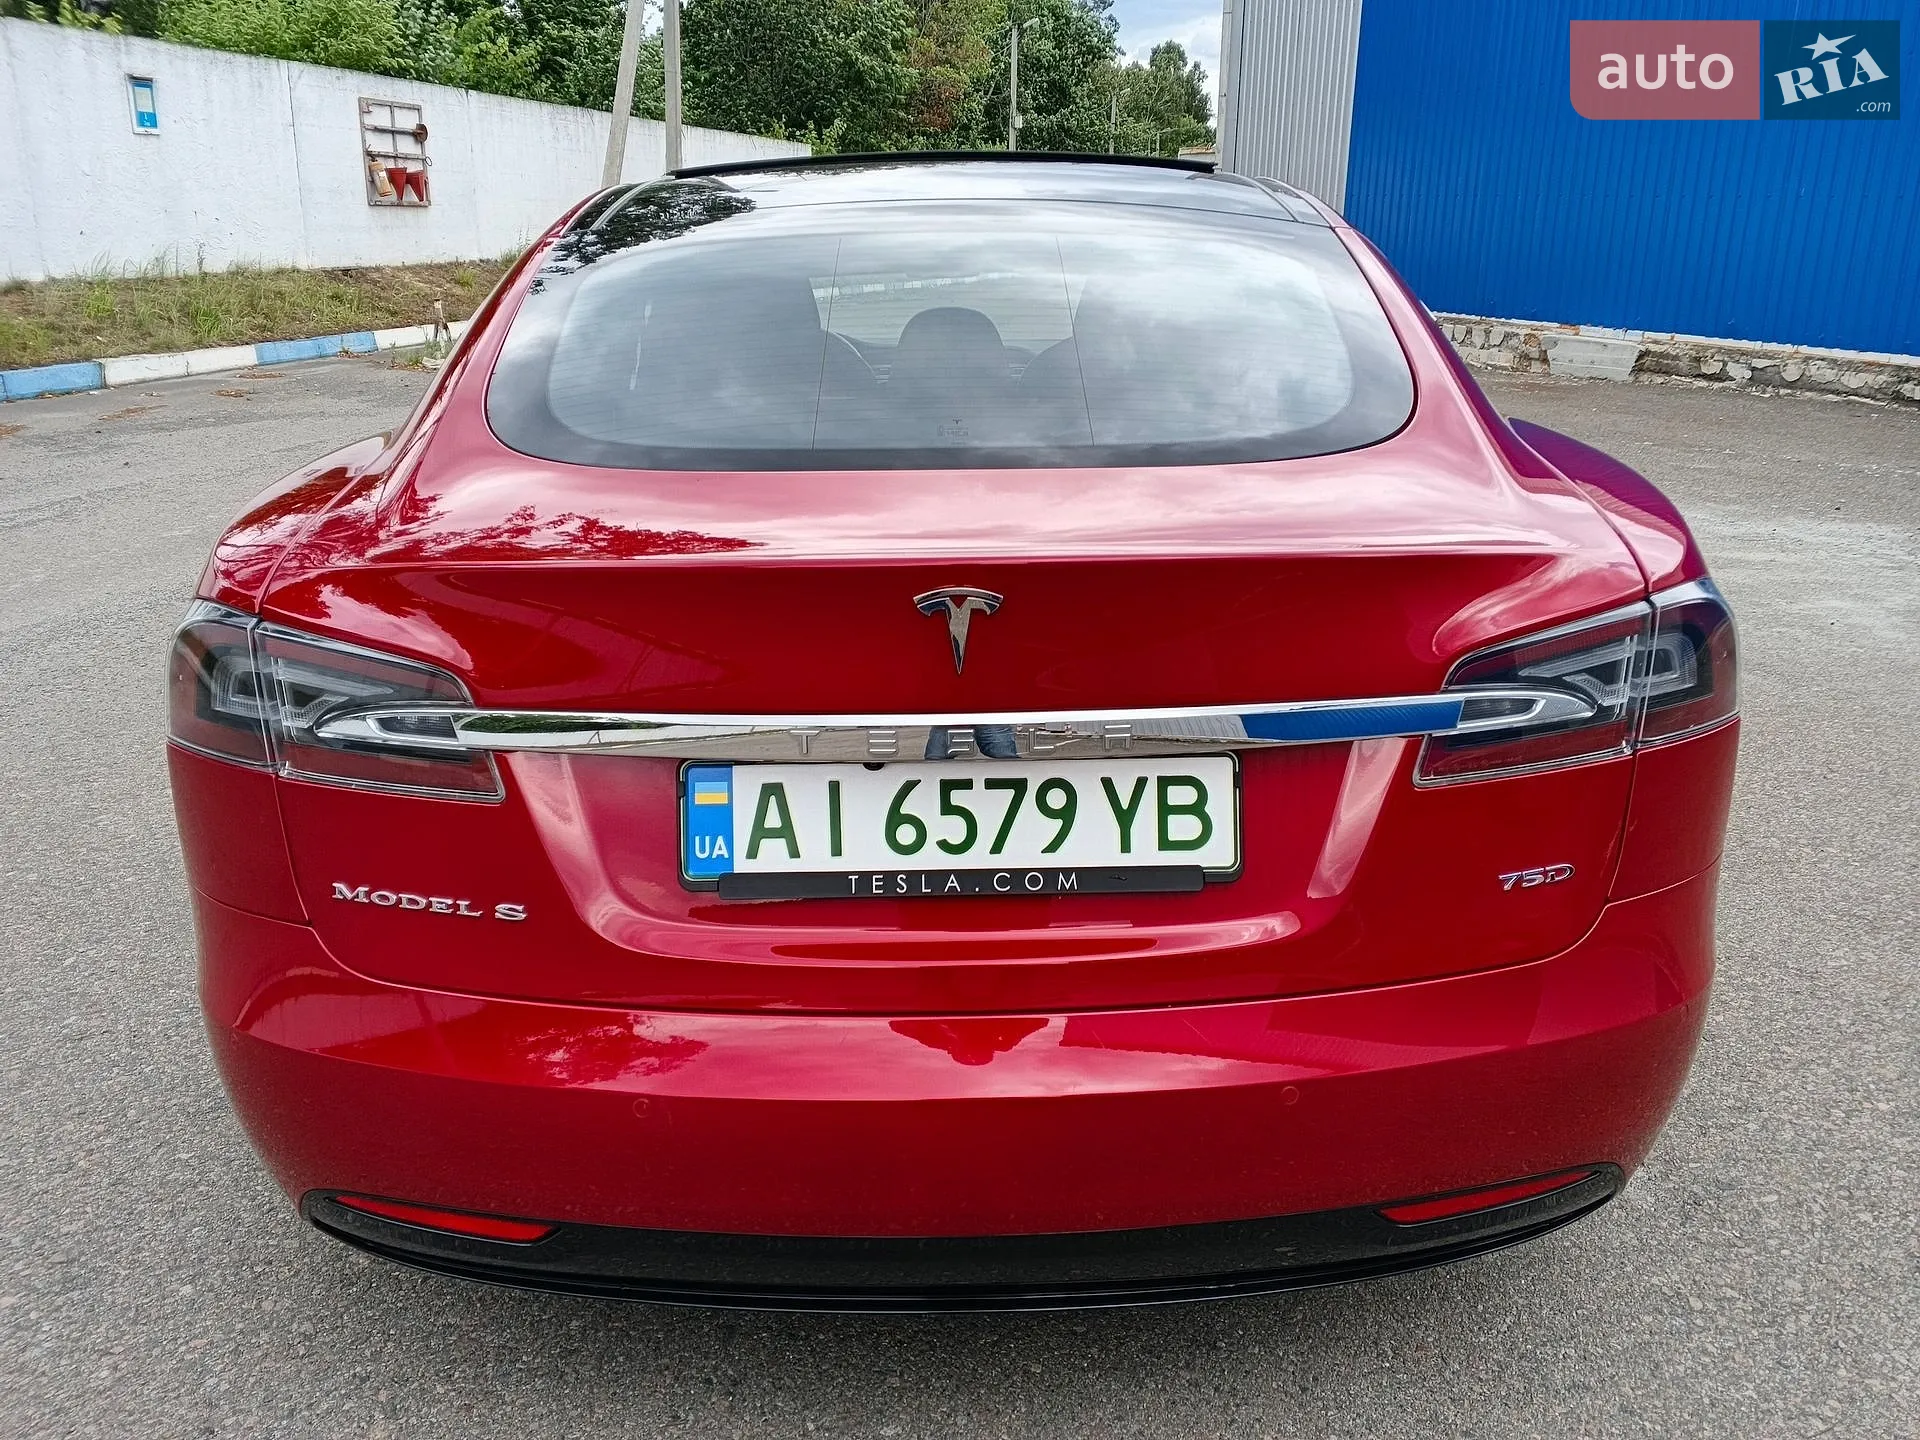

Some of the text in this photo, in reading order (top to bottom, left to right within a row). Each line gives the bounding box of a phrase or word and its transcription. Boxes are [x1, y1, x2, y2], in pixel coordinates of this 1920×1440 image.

[788, 722, 1133, 756] TESLA
[745, 774, 1214, 860] AI 6579 YB
[694, 835, 729, 859] UA
[847, 871, 1078, 895] TESLA.COM
[1498, 863, 1576, 891] 75D
[494, 902, 528, 921] S
